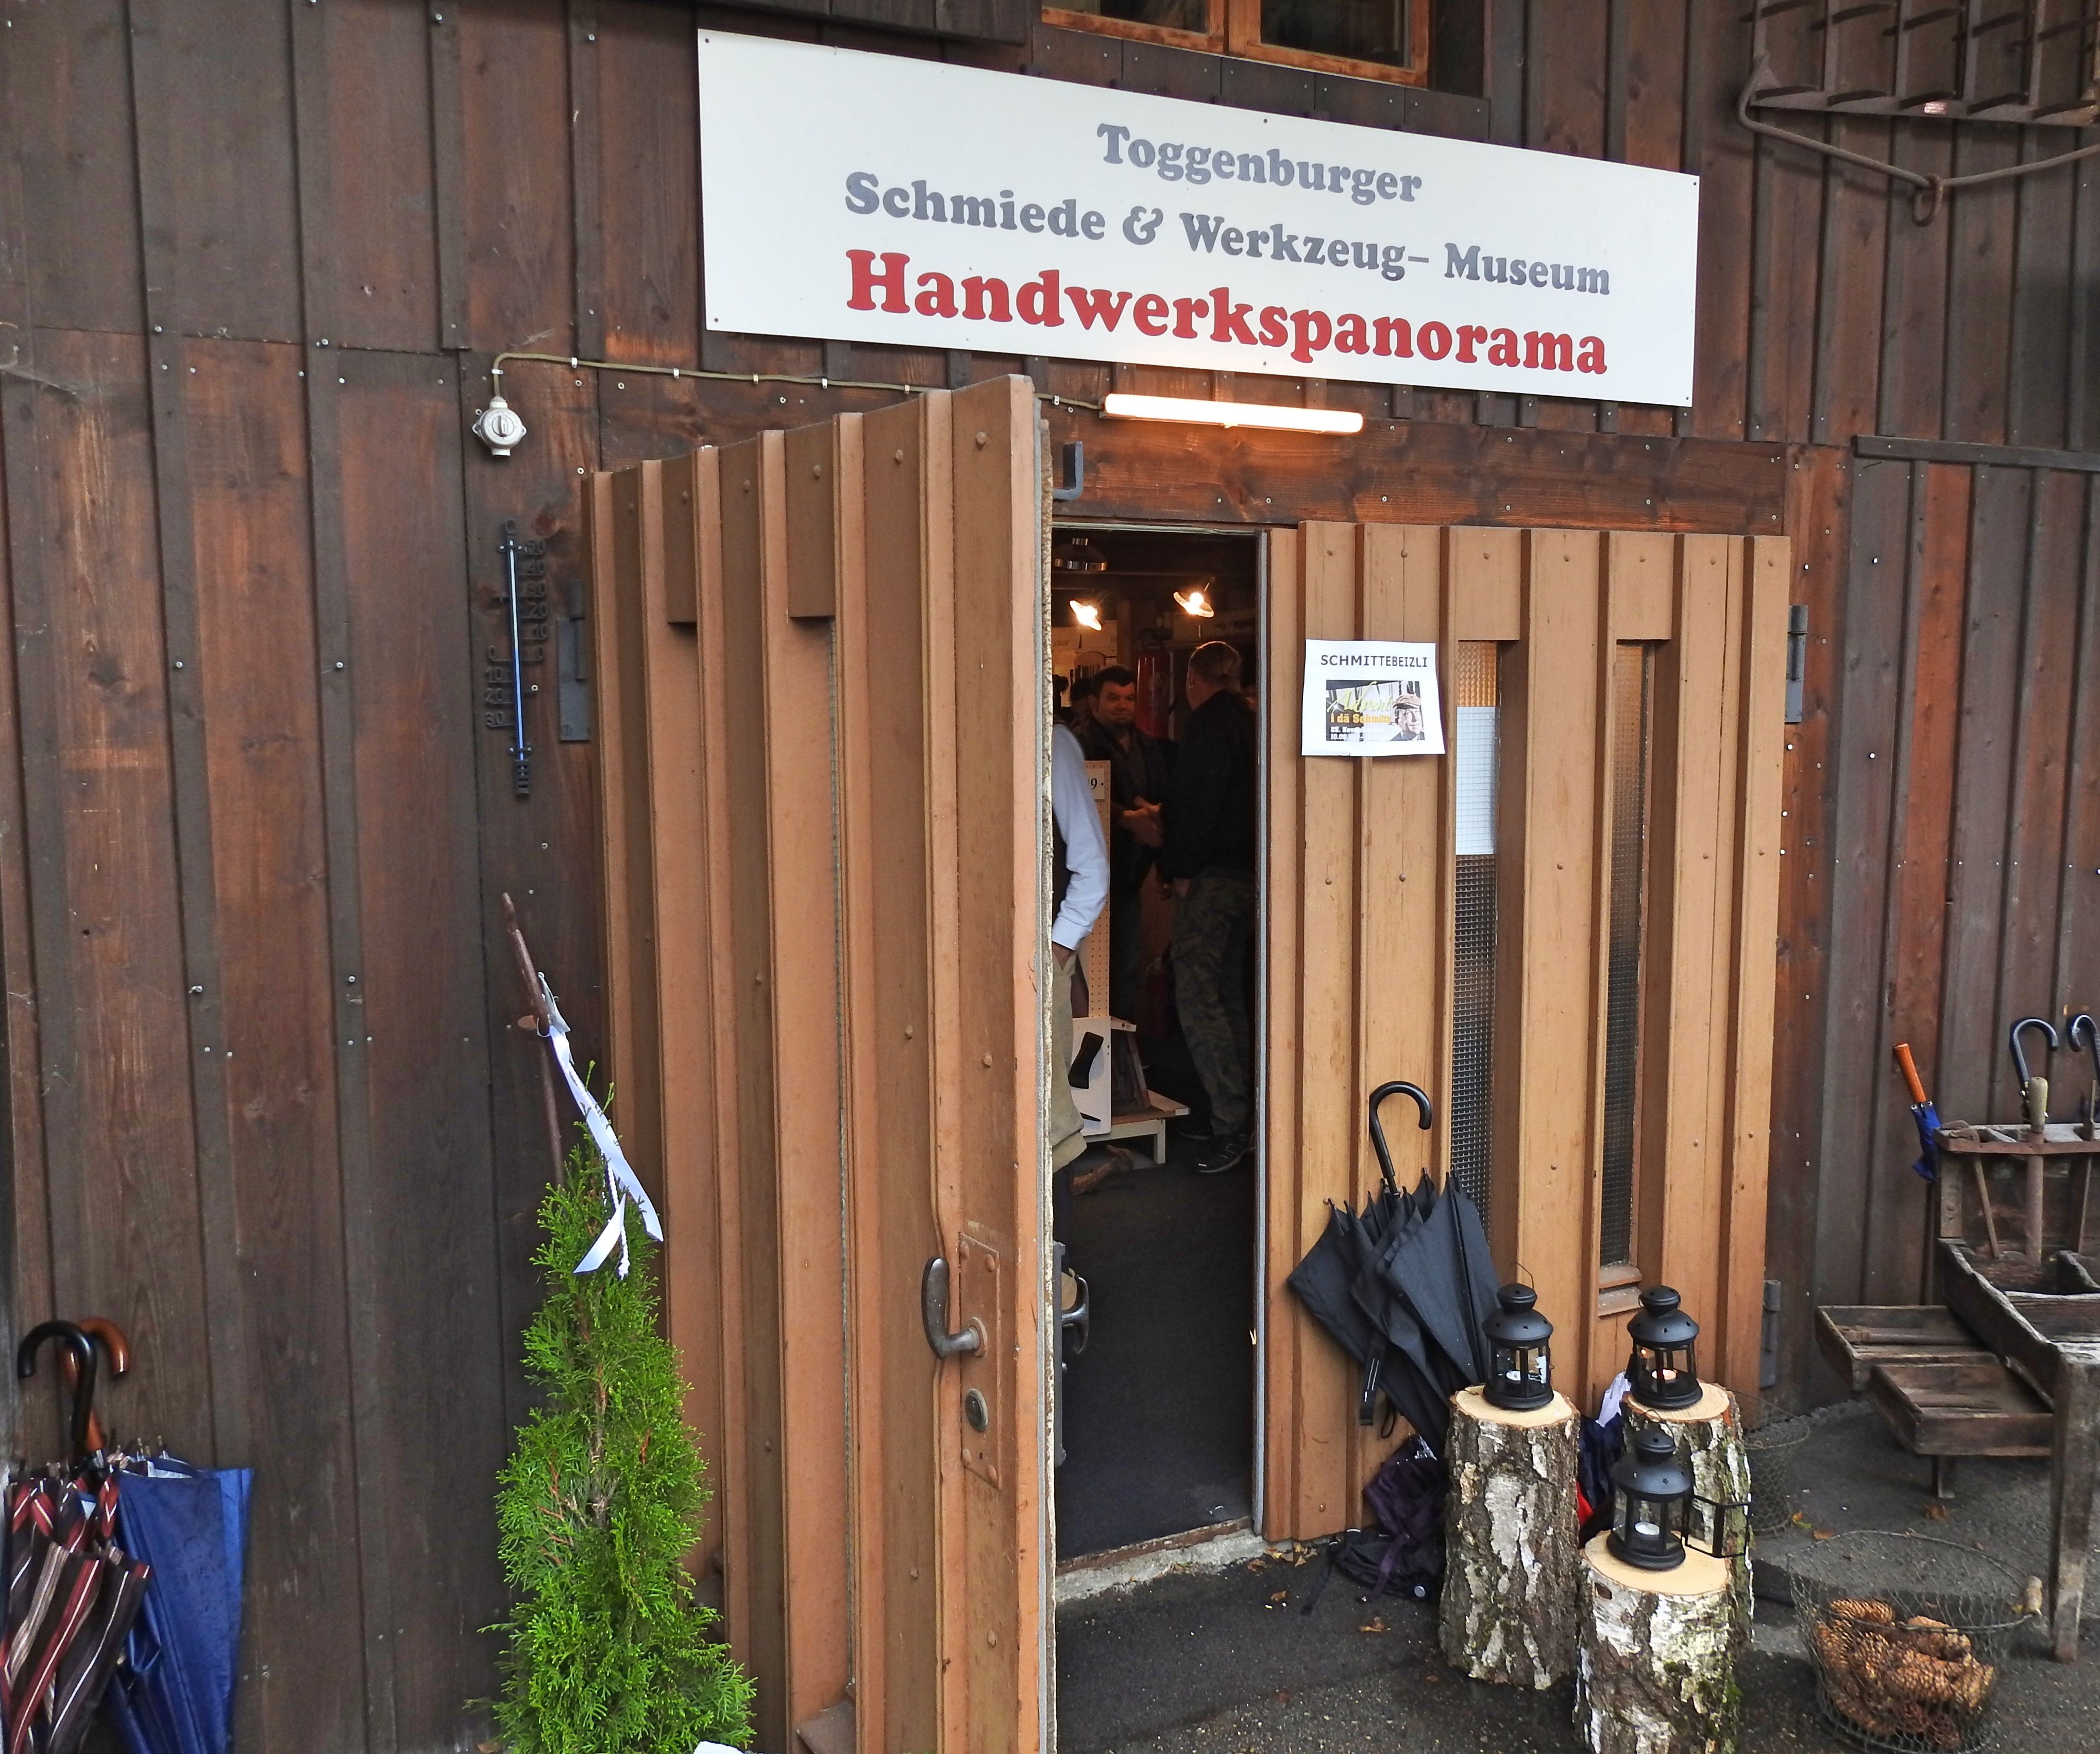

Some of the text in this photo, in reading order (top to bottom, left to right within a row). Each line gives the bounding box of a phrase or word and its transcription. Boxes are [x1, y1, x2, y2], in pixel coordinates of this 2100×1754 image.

[1096, 122, 1422, 206] Toggenburger
[844, 171, 1106, 241] Schmiede
[1122, 205, 1164, 246] &
[1444, 242, 1611, 296] Museum
[845, 248, 1608, 376] Handwerkspanorama
[530, 603, 547, 617] 20
[1320, 655, 1428, 667] SCHMITTEBEIZLI
[486, 667, 502, 680] 10
[485, 688, 503, 701] 20
[484, 710, 503, 725] 30
[1330, 713, 1335, 723] i
[1336, 713, 1350, 723] dä
